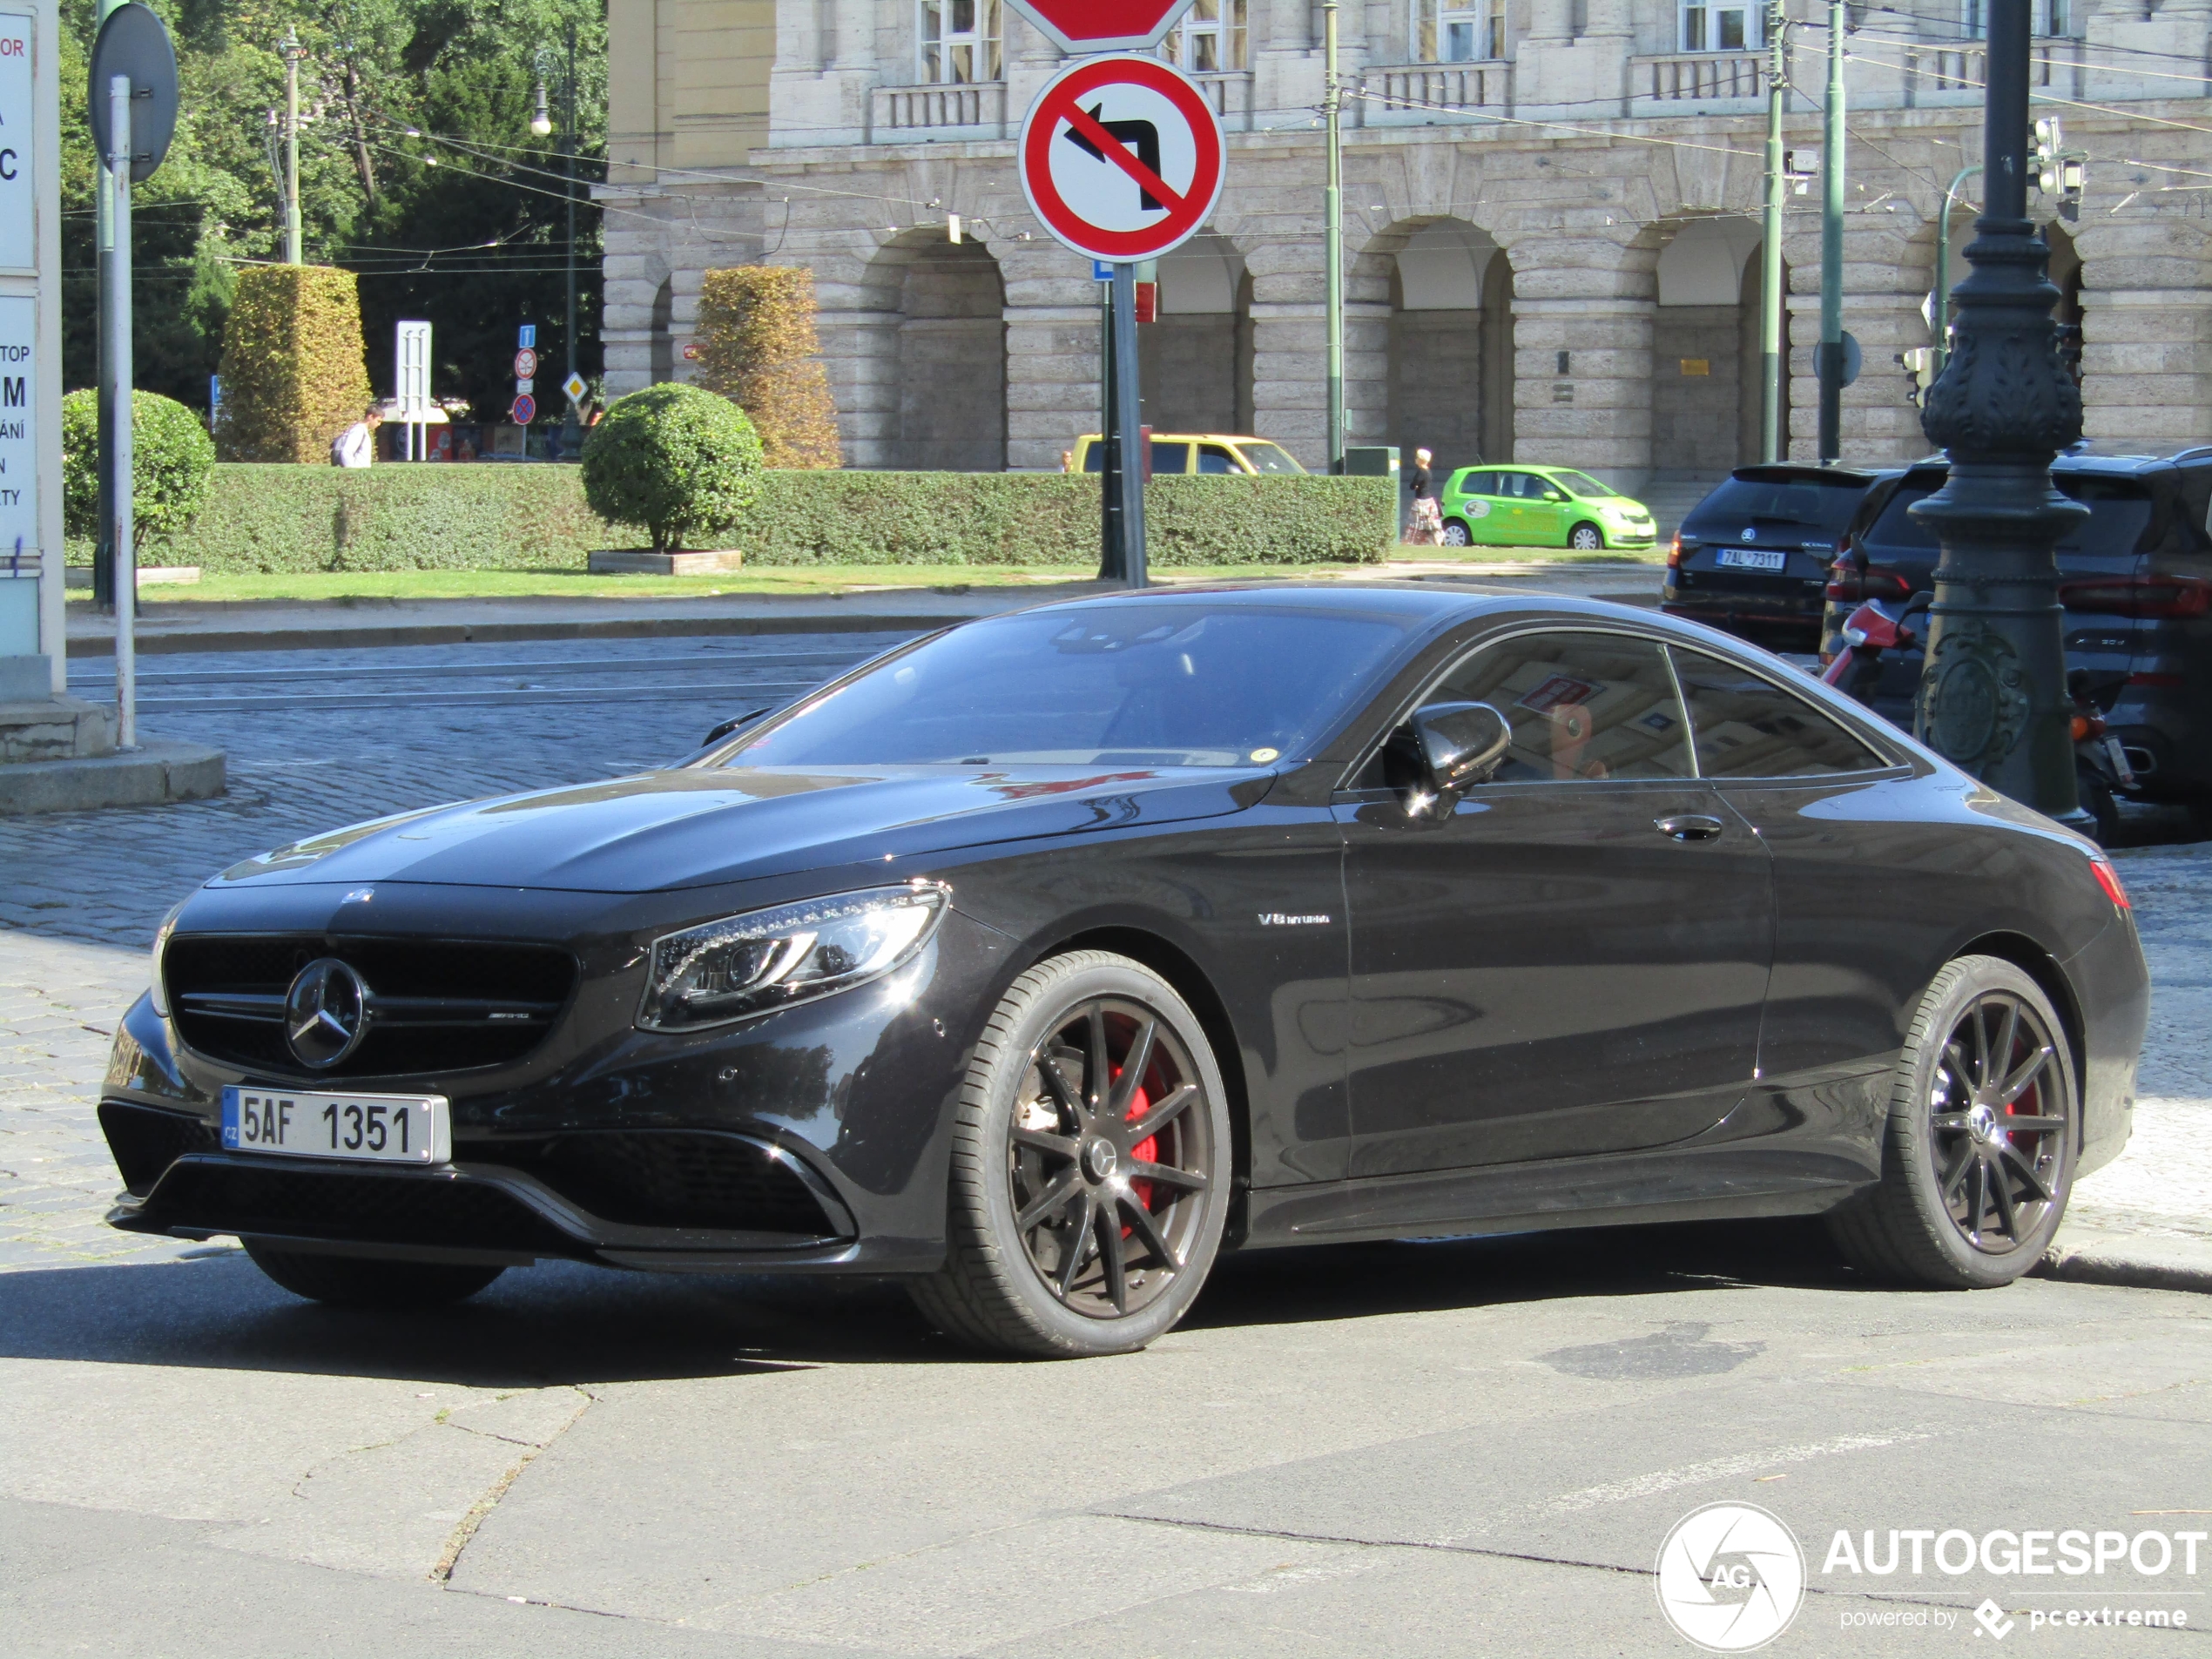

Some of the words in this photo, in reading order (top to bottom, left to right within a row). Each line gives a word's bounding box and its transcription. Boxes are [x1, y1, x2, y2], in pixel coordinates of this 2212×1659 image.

[0, 346, 30, 362] TOP
[1723, 550, 1743, 566] 7AL
[1751, 551, 1780, 568] 7311
[225, 1125, 238, 1141] CZ
[244, 1096, 295, 1145] 5AF
[322, 1103, 409, 1154] 1351
